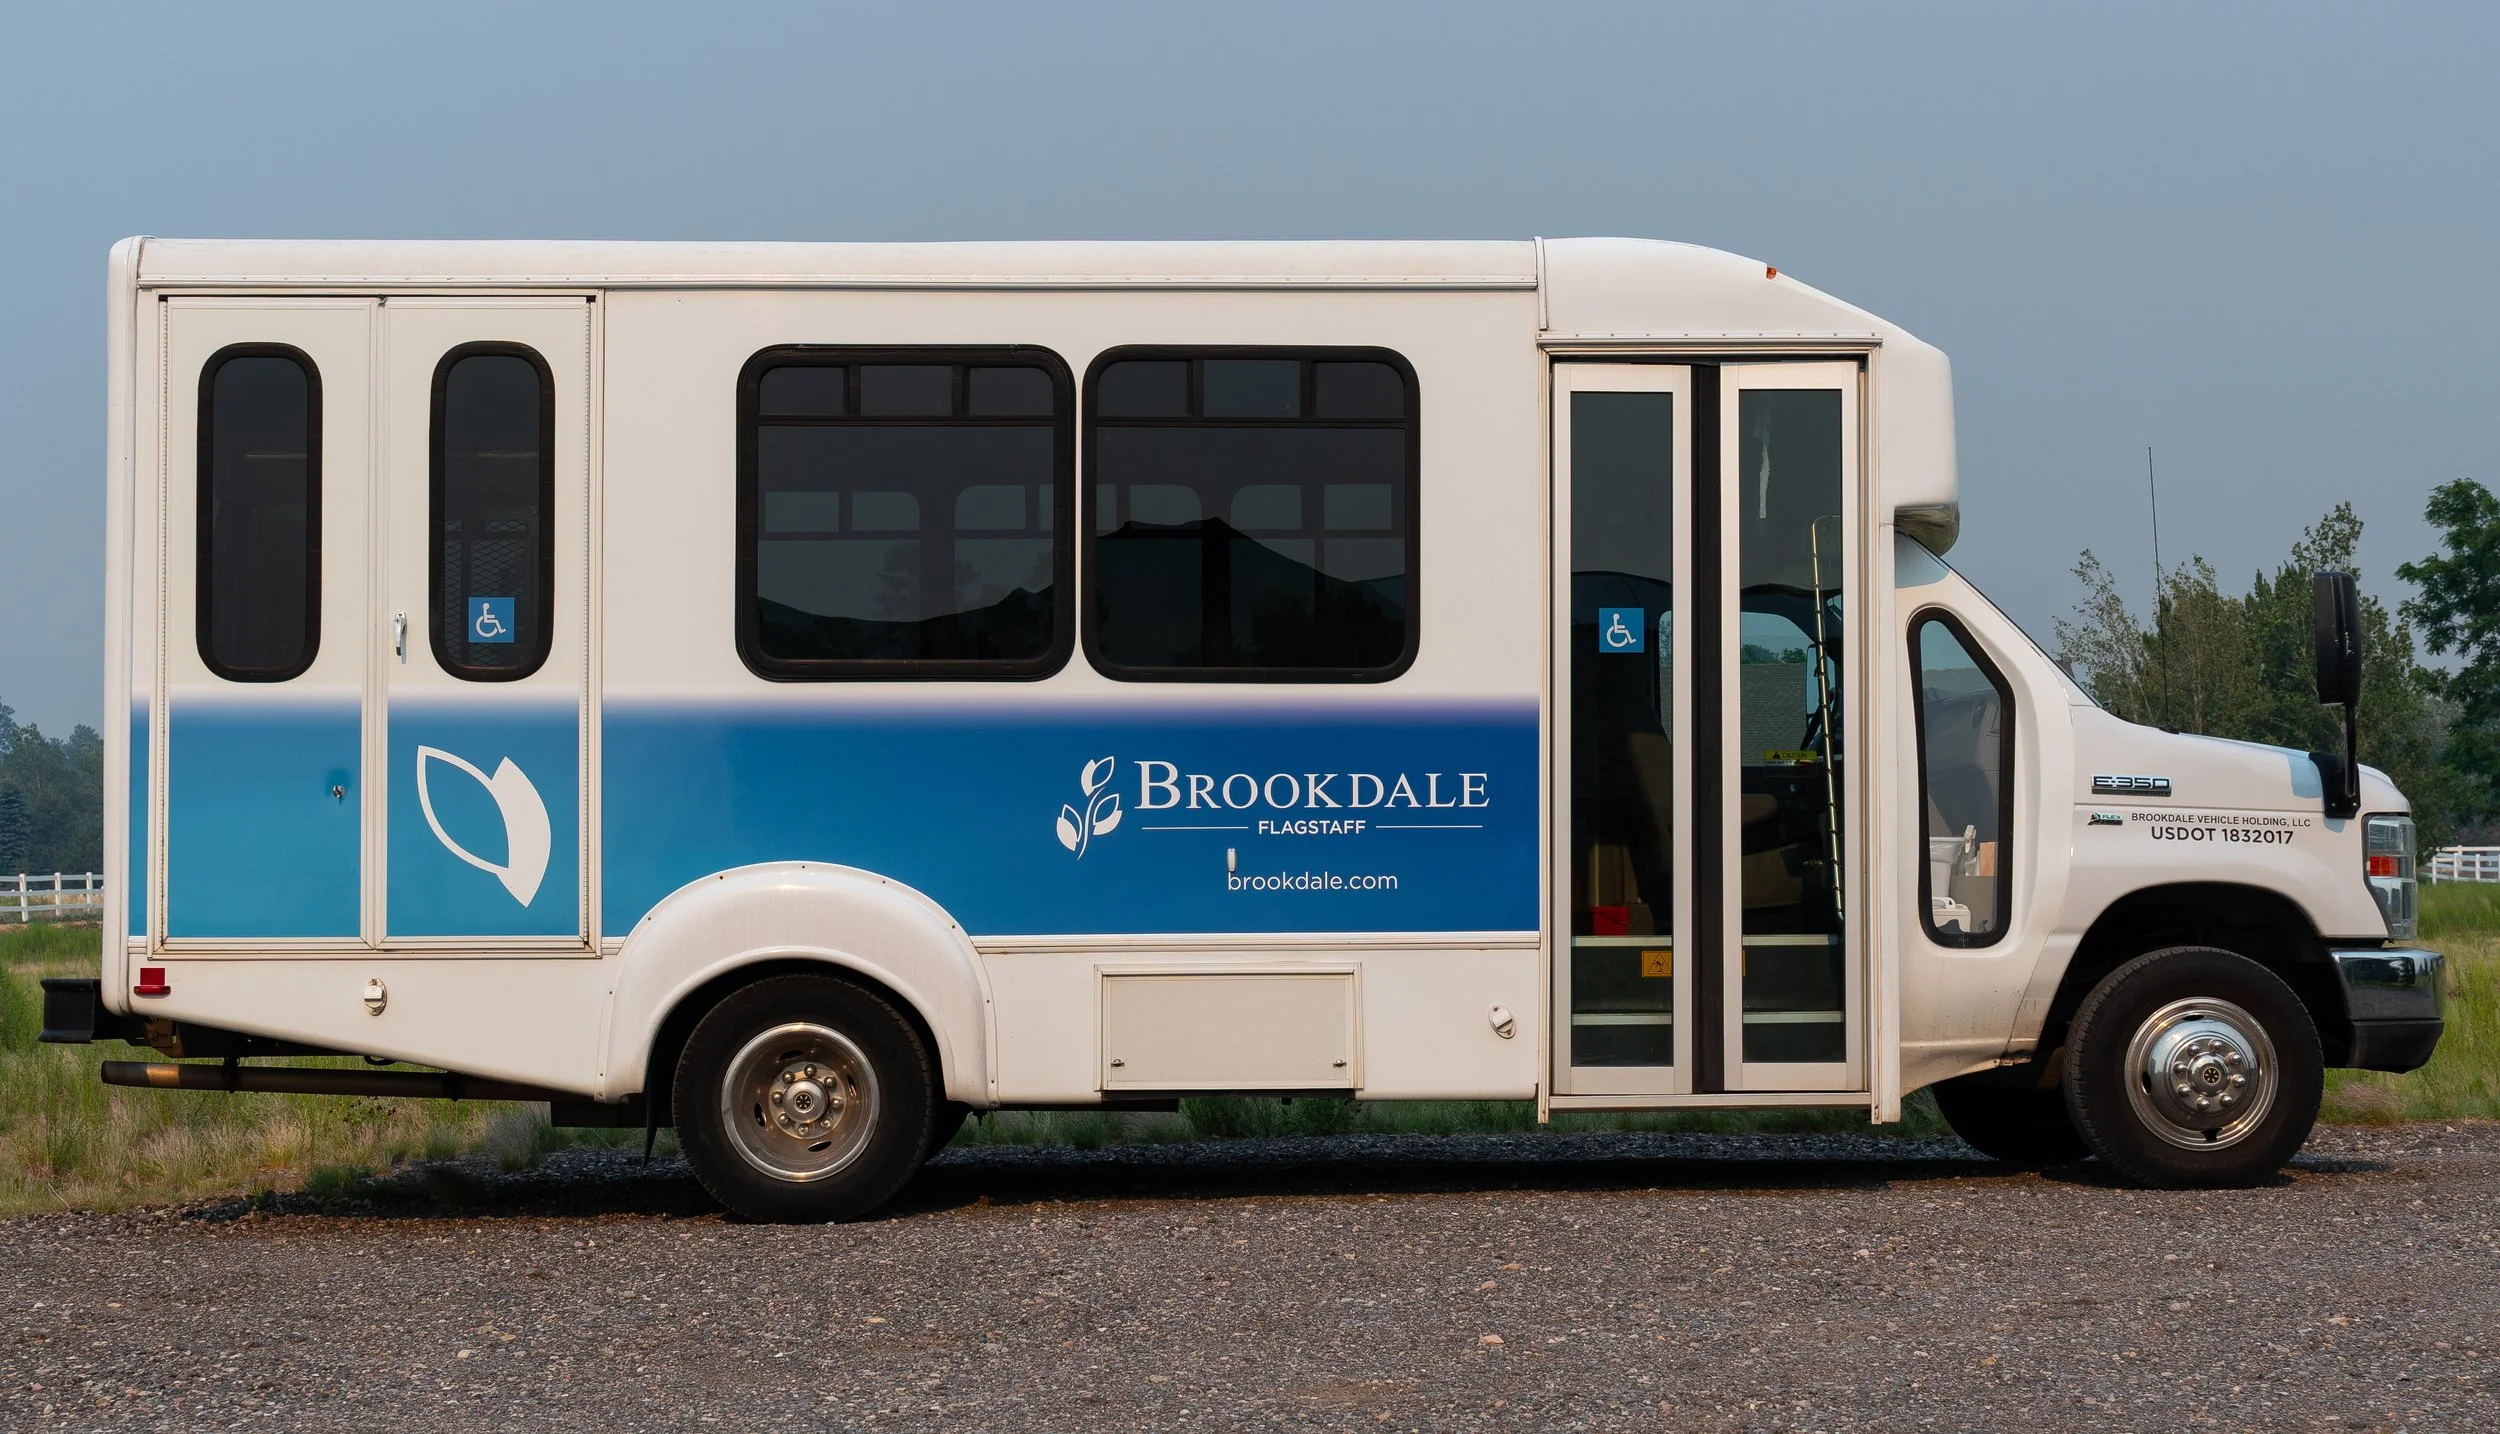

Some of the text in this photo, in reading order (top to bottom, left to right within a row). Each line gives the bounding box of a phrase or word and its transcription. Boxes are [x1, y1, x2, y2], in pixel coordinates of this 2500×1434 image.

[1134, 760, 1490, 809] BROOKDALE
[1258, 820, 1366, 834] FLAGSTAFF
[2131, 812, 2195, 824] BROOKDALE
[2197, 815, 2240, 825] VEHICLE
[2242, 817, 2290, 828] HOLDING,
[2292, 818, 2311, 828] LLC
[2151, 826, 2294, 845] USDOT 1832017
[1228, 871, 1398, 890] brookdale.com
